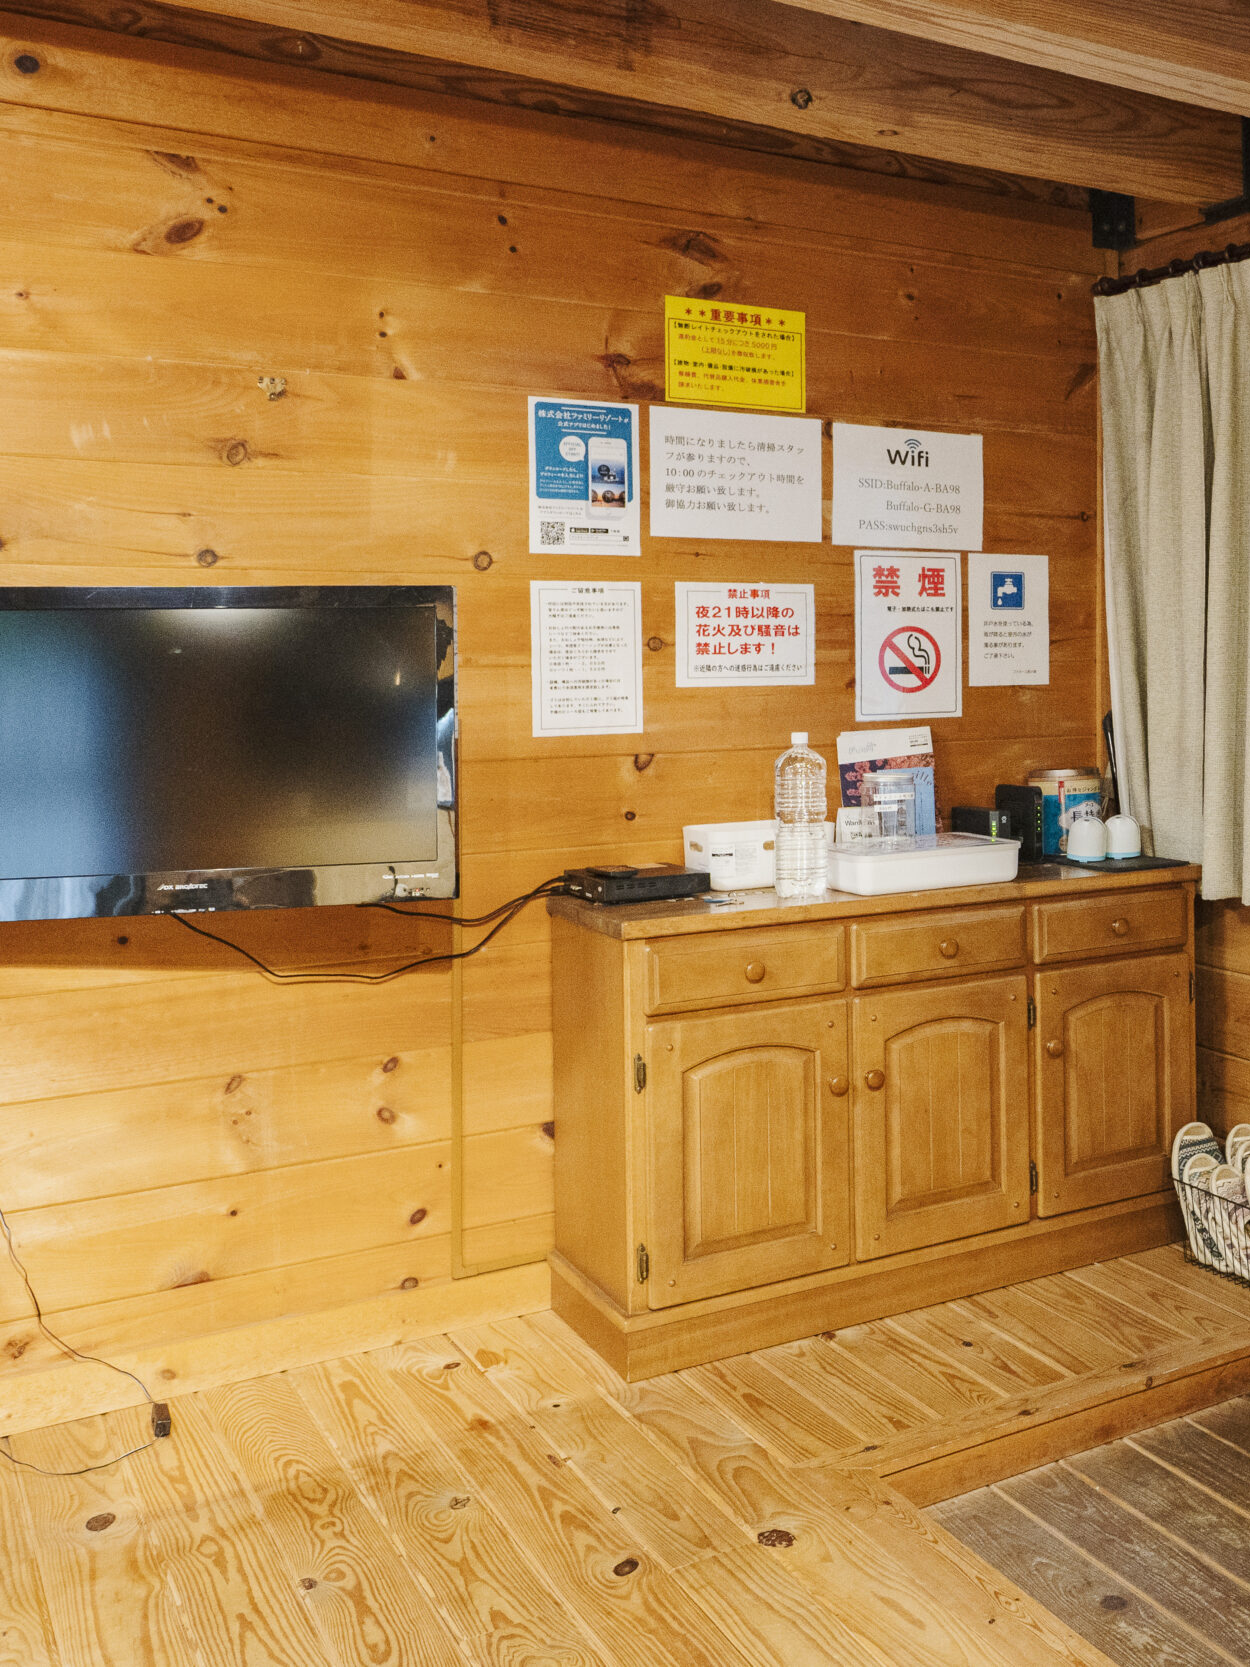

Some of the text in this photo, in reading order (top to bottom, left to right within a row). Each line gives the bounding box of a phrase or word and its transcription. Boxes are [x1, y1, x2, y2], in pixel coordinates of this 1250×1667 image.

[711, 308, 762, 326] 重要事項
[664, 435, 805, 455] 時間になりましたら清掃スタッ
[665, 452, 751, 466] フが参りますので、
[886, 448, 929, 467] Wifi
[665, 483, 760, 498] 厳守お願い致します。
[665, 498, 770, 514] 御協力お願い致します。
[886, 500, 961, 514] Buffalo-G-BA98
[728, 588, 770, 599] 禁止事項
[695, 606, 794, 619] 夜21時以降の
[695, 624, 800, 637] 花火及び騒音は
[695, 642, 775, 655] 禁止します!
